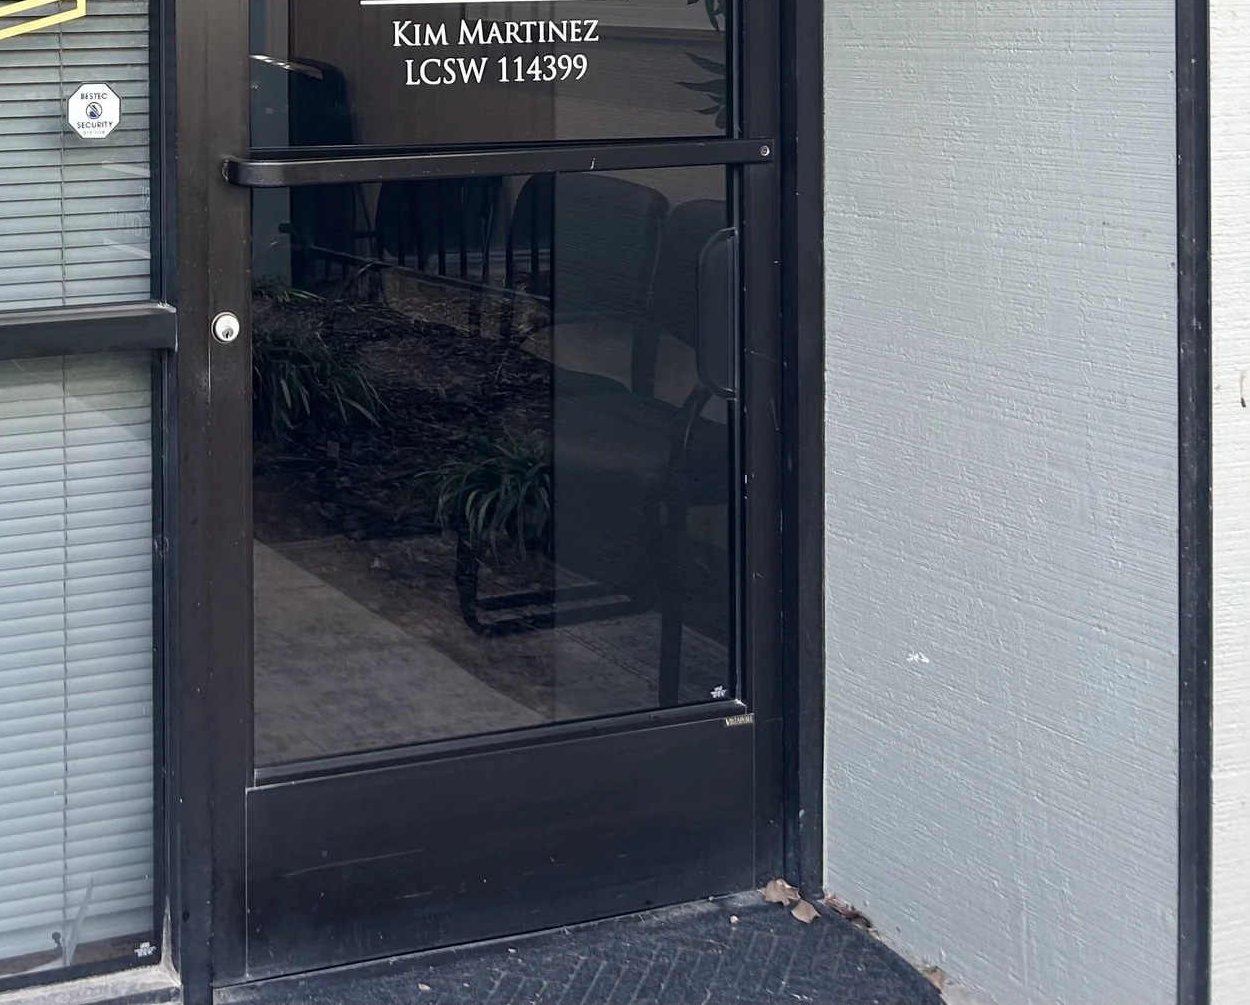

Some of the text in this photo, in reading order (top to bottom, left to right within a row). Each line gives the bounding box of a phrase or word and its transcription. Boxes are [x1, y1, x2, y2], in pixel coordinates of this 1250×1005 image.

[392, 18, 599, 47] KIM MARTINEZ
[405, 54, 588, 86] LCSW 114399
[76, 121, 113, 129] SECURITY
